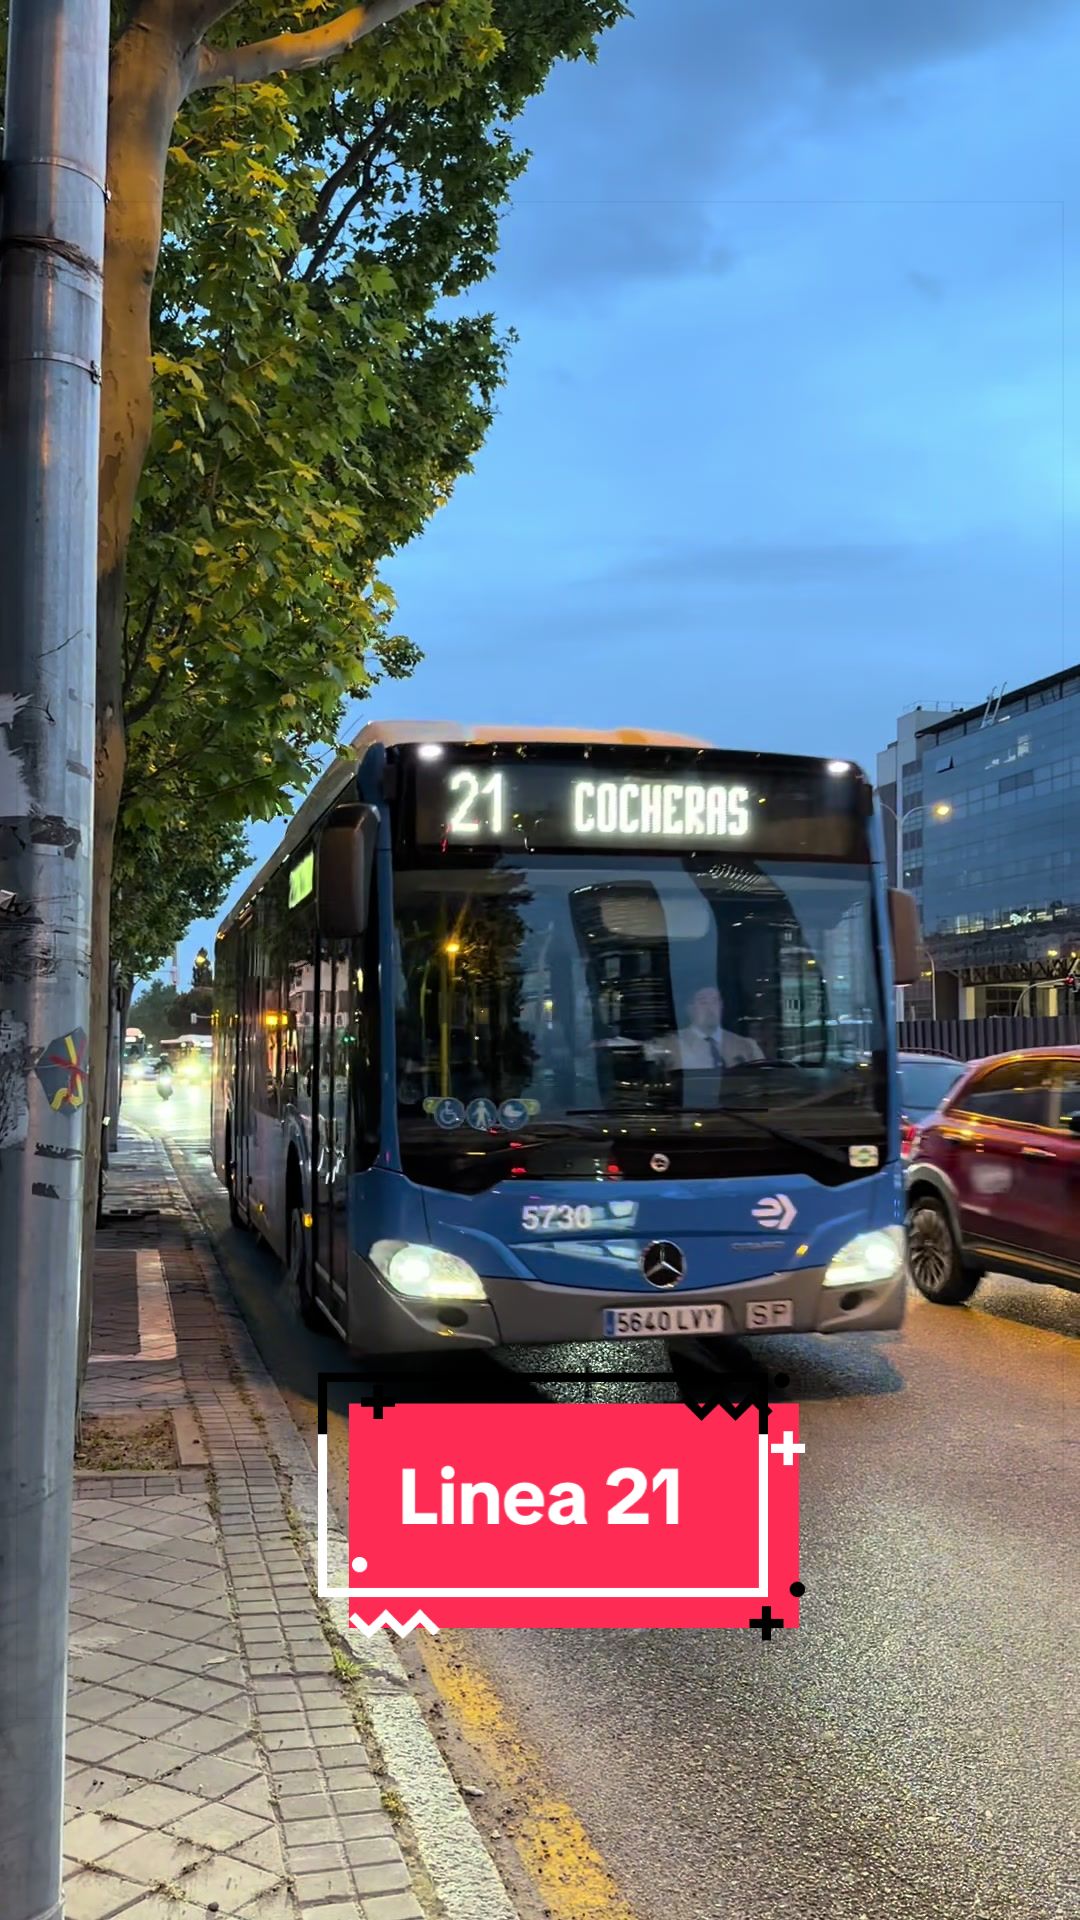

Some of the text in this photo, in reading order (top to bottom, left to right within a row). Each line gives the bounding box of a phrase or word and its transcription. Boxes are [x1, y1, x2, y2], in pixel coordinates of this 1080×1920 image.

[450, 771, 749, 836] 21 COCHERAS
[522, 1204, 592, 1231] 5730
[617, 1307, 717, 1333] 5640 LVY
[752, 1303, 787, 1326] SP
